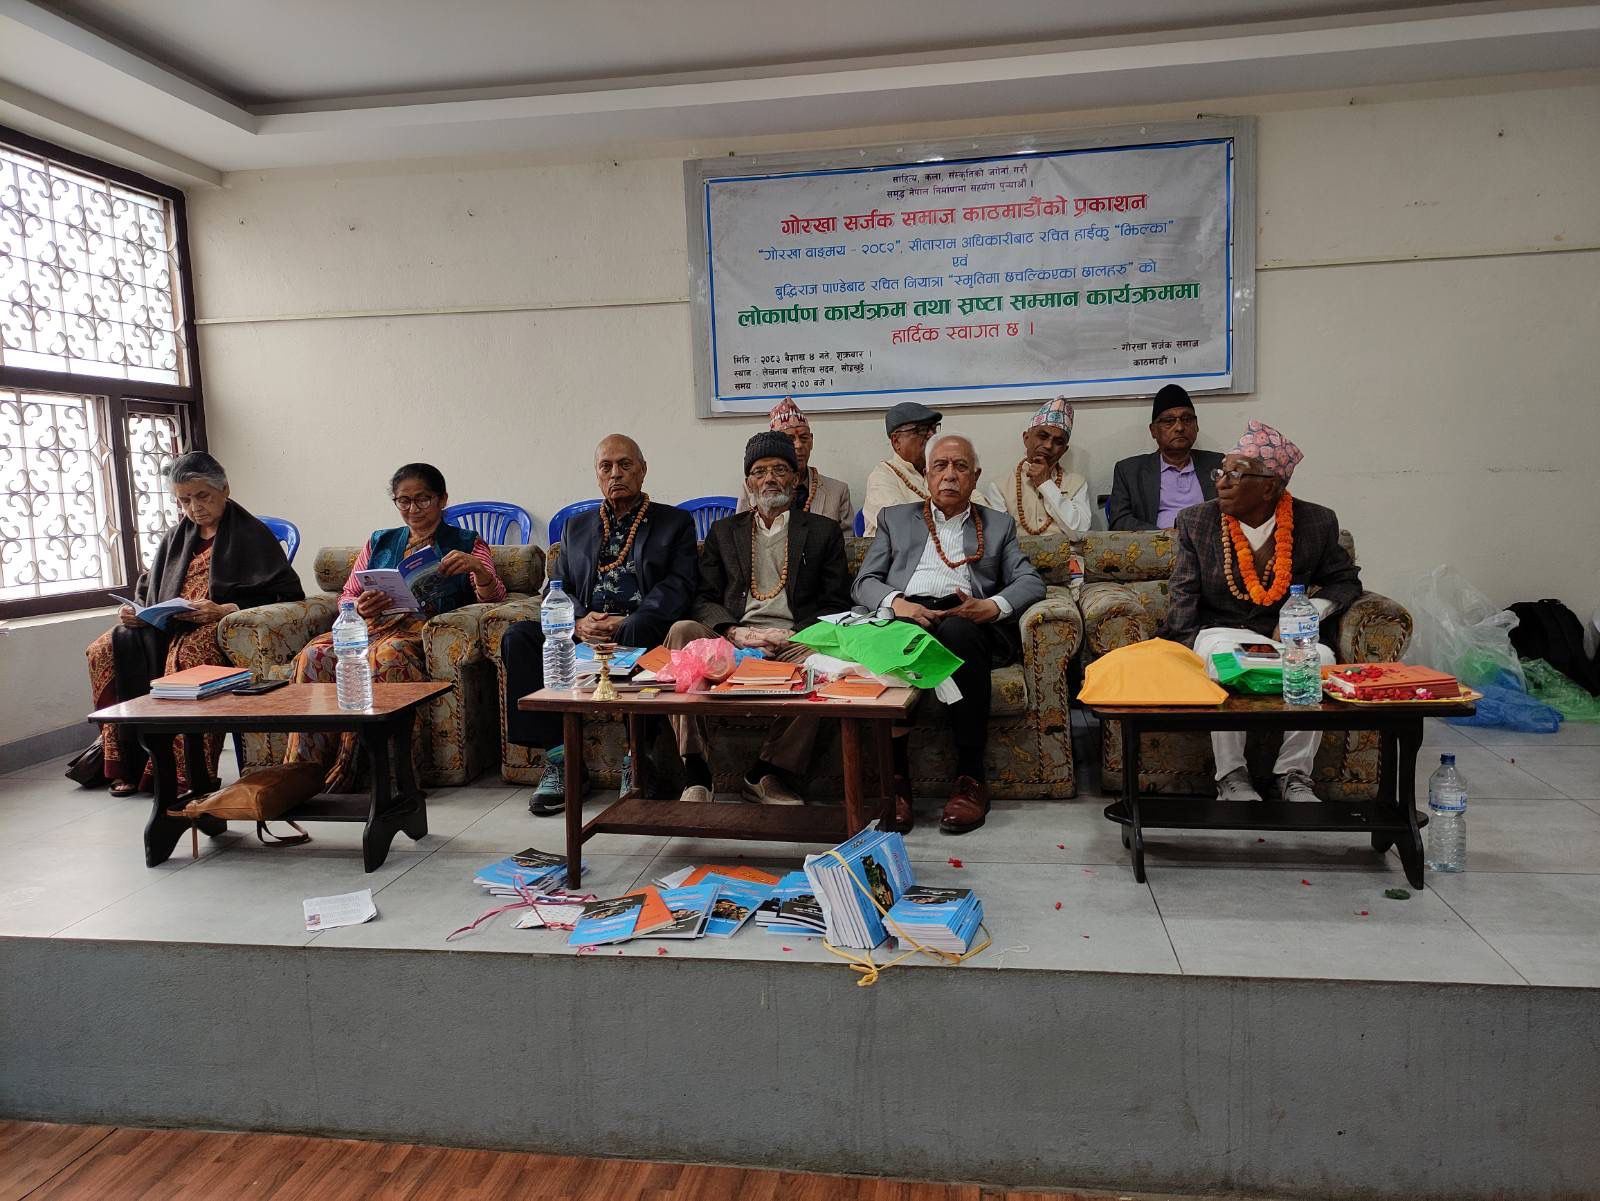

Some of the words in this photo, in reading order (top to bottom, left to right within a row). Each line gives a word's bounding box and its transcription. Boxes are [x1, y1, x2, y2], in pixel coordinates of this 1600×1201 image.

[909, 187, 929, 197] नेपाल
[781, 214, 836, 235] गोरखा
[843, 209, 895, 232] सर्जक
[901, 208, 956, 227] समाज
[963, 195, 1068, 222] काठमाडौंको
[1073, 193, 1148, 218] प्रकाशन
[908, 238, 957, 251] सीताराम
[961, 232, 1035, 249] अधिकारीबाट
[1039, 229, 1070, 243] रचित
[1075, 225, 1110, 242] हाईकु
[952, 254, 968, 268] एवं
[774, 283, 818, 300] बुद्धिराज
[822, 279, 866, 294] पाण्डेबाट
[871, 278, 899, 291] रचित
[1138, 258, 1157, 273] को
[738, 305, 818, 326] लोकार्पण
[825, 300, 907, 321] कार्यक्रम
[914, 299, 952, 316] तथा
[957, 296, 1004, 316] स्रष्टा
[1010, 291, 1080, 312] सम्मान
[1086, 283, 1200, 306] कार्यक्रममा
[891, 323, 940, 345] हार्दिक
[946, 323, 1000, 340] स्वागत
[1006, 322, 1019, 337] छ
[1121, 342, 1147, 352] गोरखा
[1176, 340, 1200, 349] समाज
[733, 354, 750, 365] मिति
[791, 365, 815, 375] साहित्य
[734, 383, 752, 391] समय
[813, 378, 825, 387] बजे
